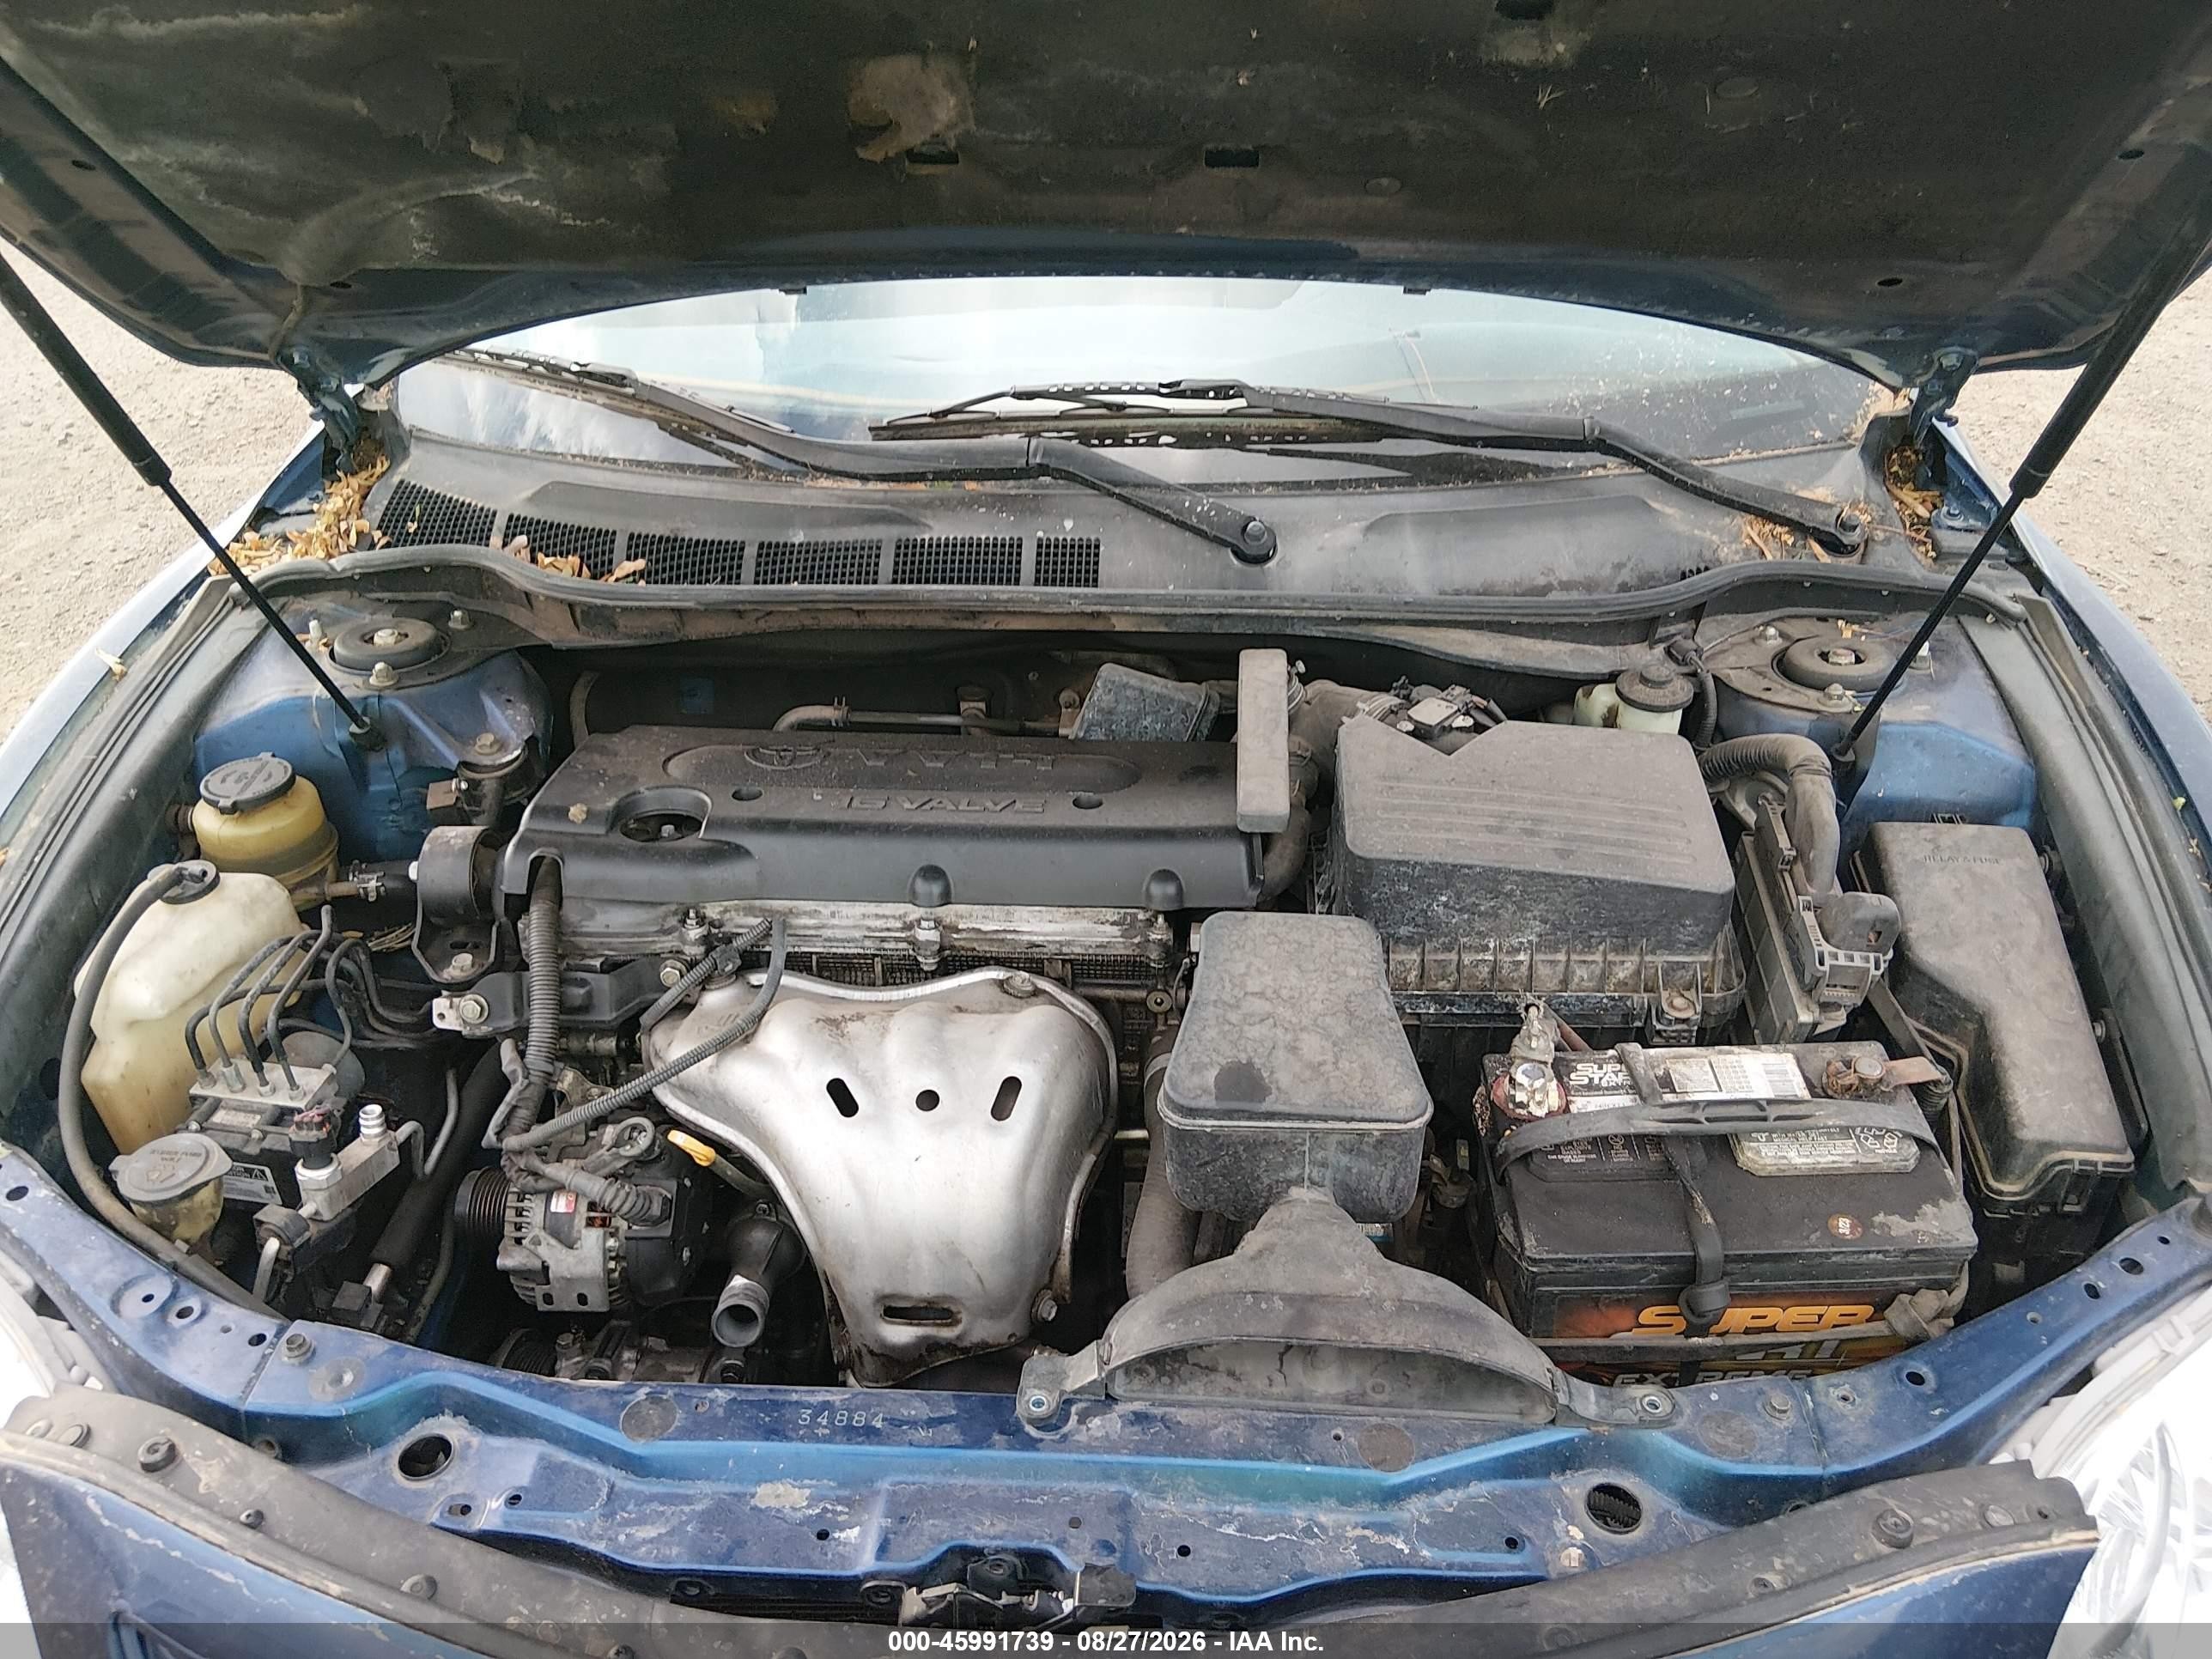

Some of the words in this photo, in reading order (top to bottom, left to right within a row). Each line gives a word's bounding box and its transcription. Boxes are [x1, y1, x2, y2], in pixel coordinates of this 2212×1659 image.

[898, 796, 1046, 813] VALVE
[1575, 1062, 1626, 1074] SUP
[798, 1408, 884, 1429] 34884
